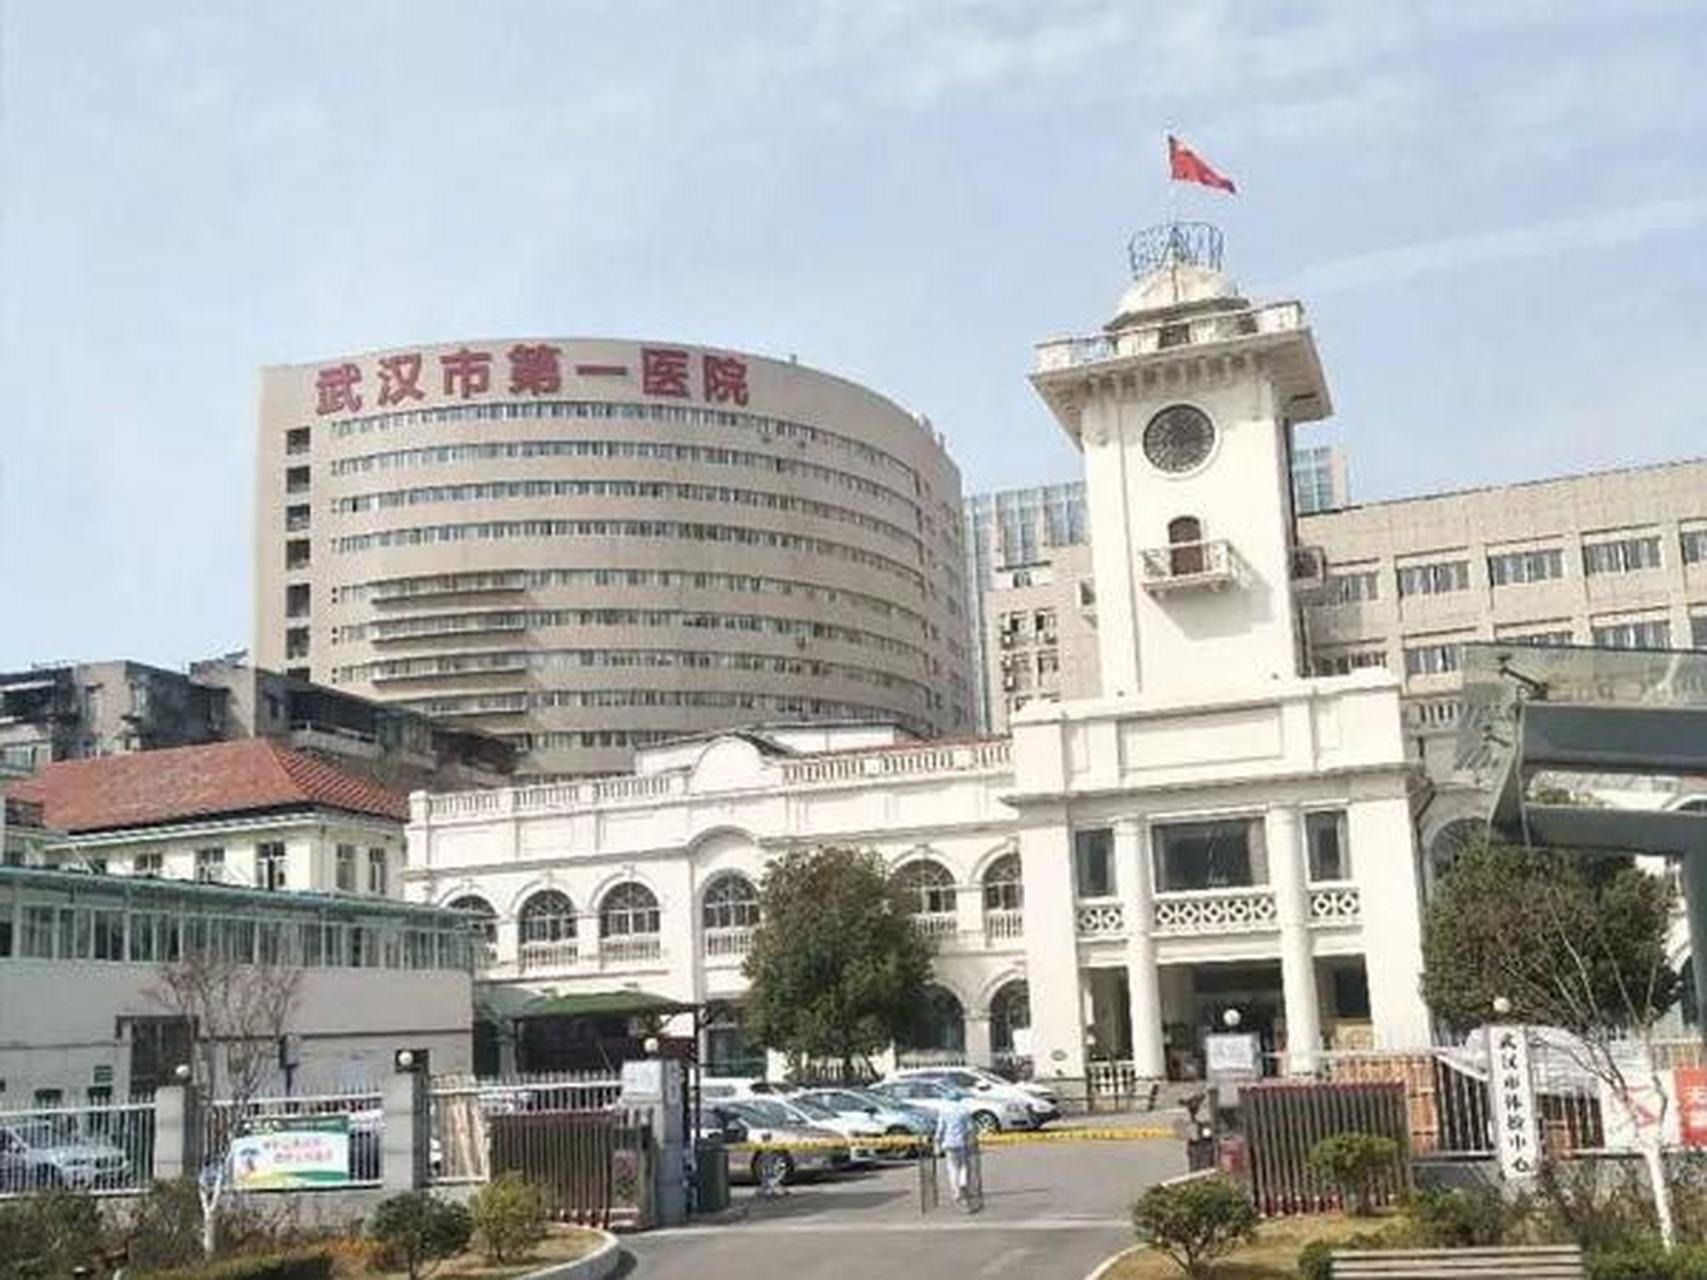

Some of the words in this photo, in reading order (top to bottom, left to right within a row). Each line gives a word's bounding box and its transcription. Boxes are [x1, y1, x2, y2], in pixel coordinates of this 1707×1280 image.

[315, 344, 749, 415] 武汉市第一医院
